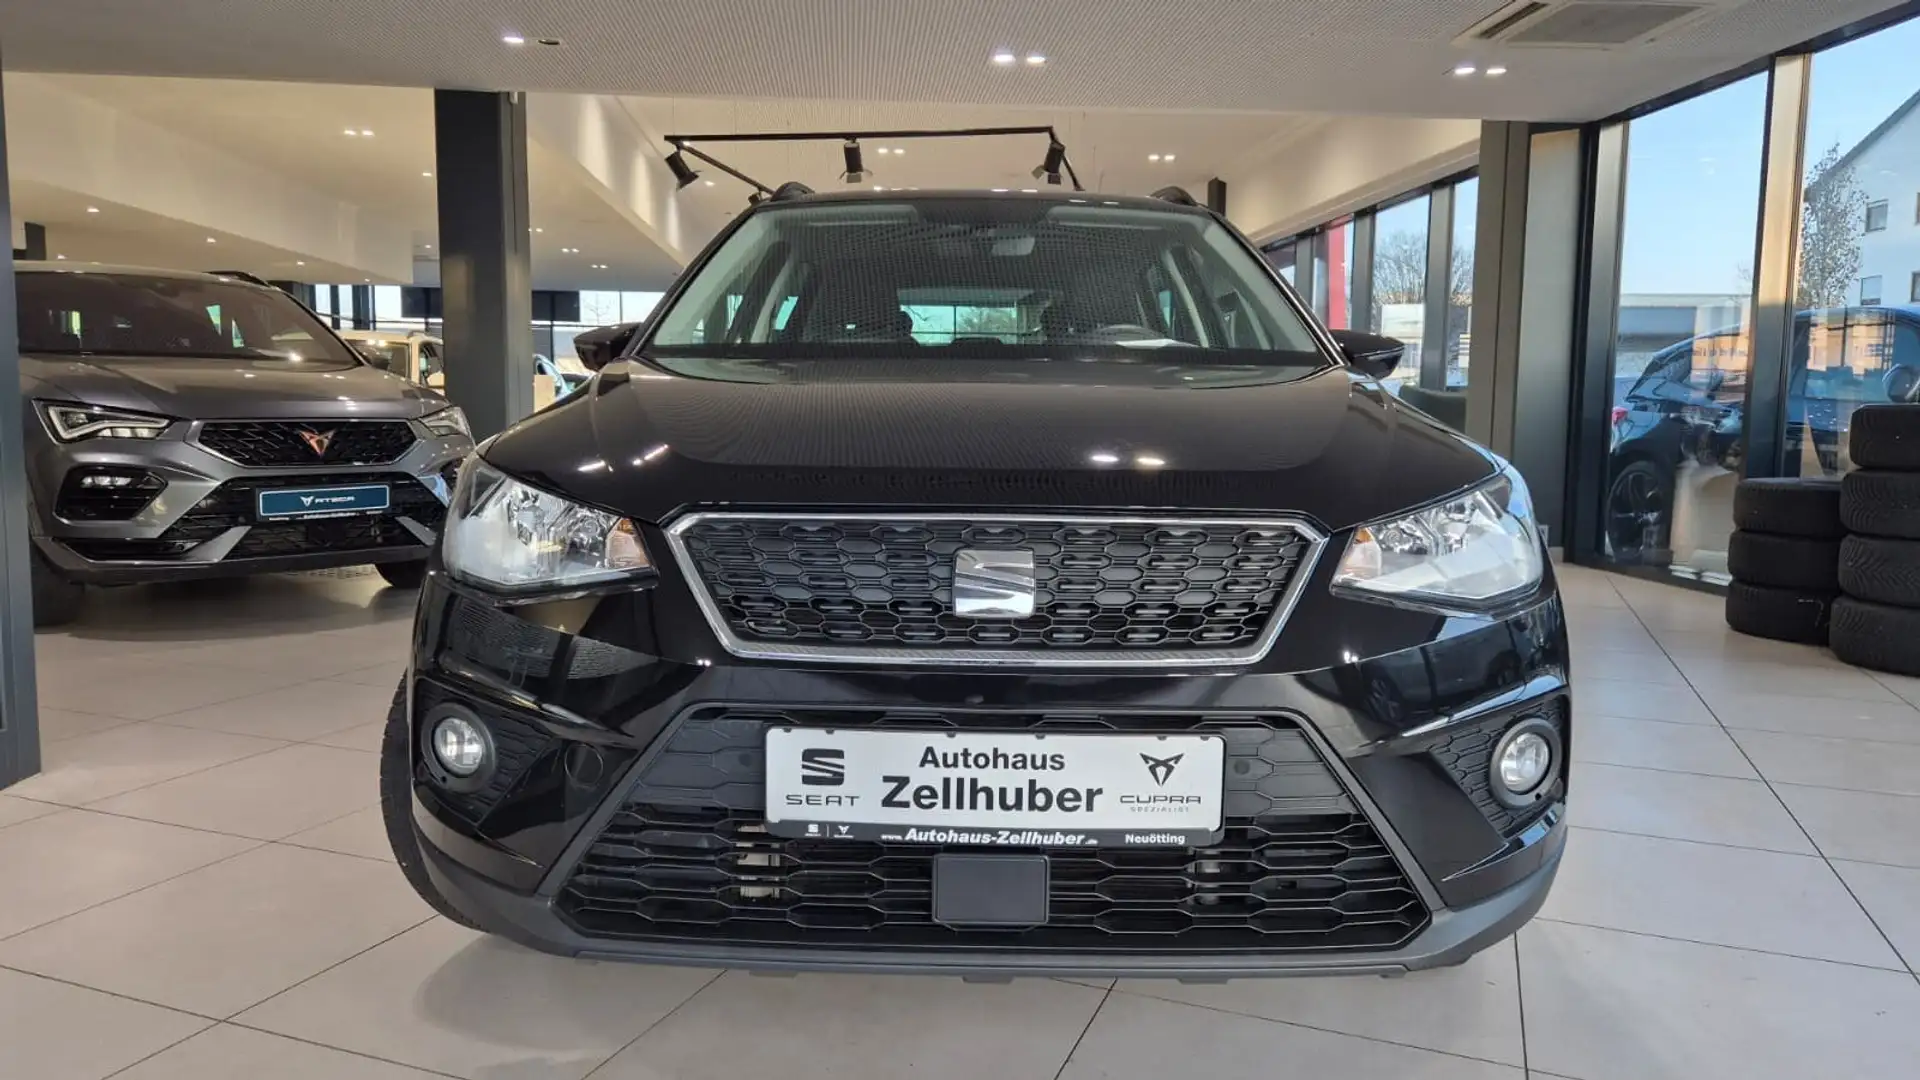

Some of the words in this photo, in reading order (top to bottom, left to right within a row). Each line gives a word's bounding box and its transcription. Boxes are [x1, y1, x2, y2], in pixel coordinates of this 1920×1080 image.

[919, 746, 1066, 771] Autohaus
[881, 775, 1103, 812] Zellhuber
[1119, 795, 1202, 805] CUPRA
[785, 794, 861, 807] SEAT
[1124, 833, 1186, 845] Neuötting
